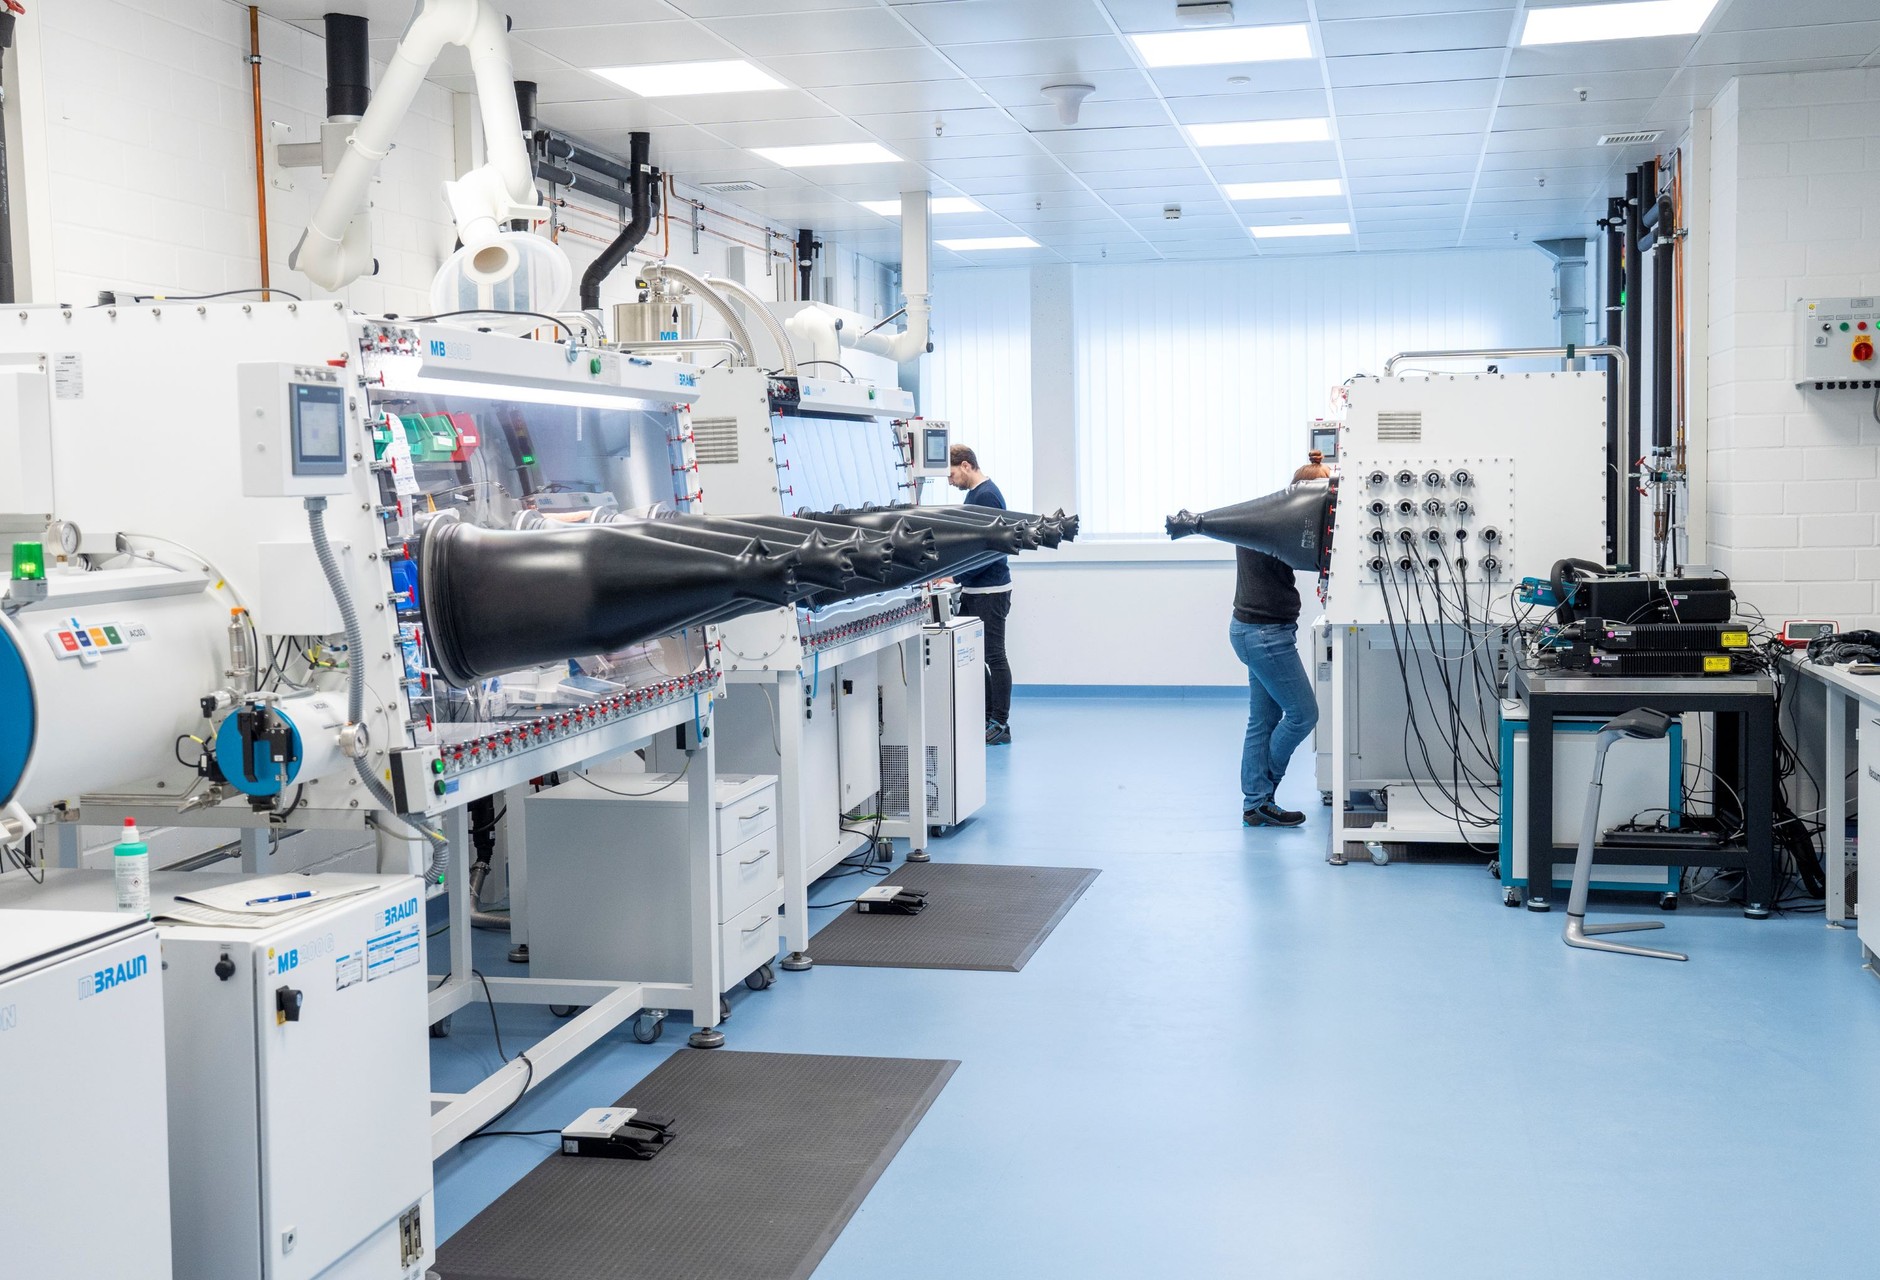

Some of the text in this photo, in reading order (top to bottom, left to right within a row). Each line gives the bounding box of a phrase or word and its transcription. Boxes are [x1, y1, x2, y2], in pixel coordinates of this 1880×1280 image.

[660, 332, 679, 341] MB
[430, 340, 446, 356] MB
[278, 949, 299, 975] MB
